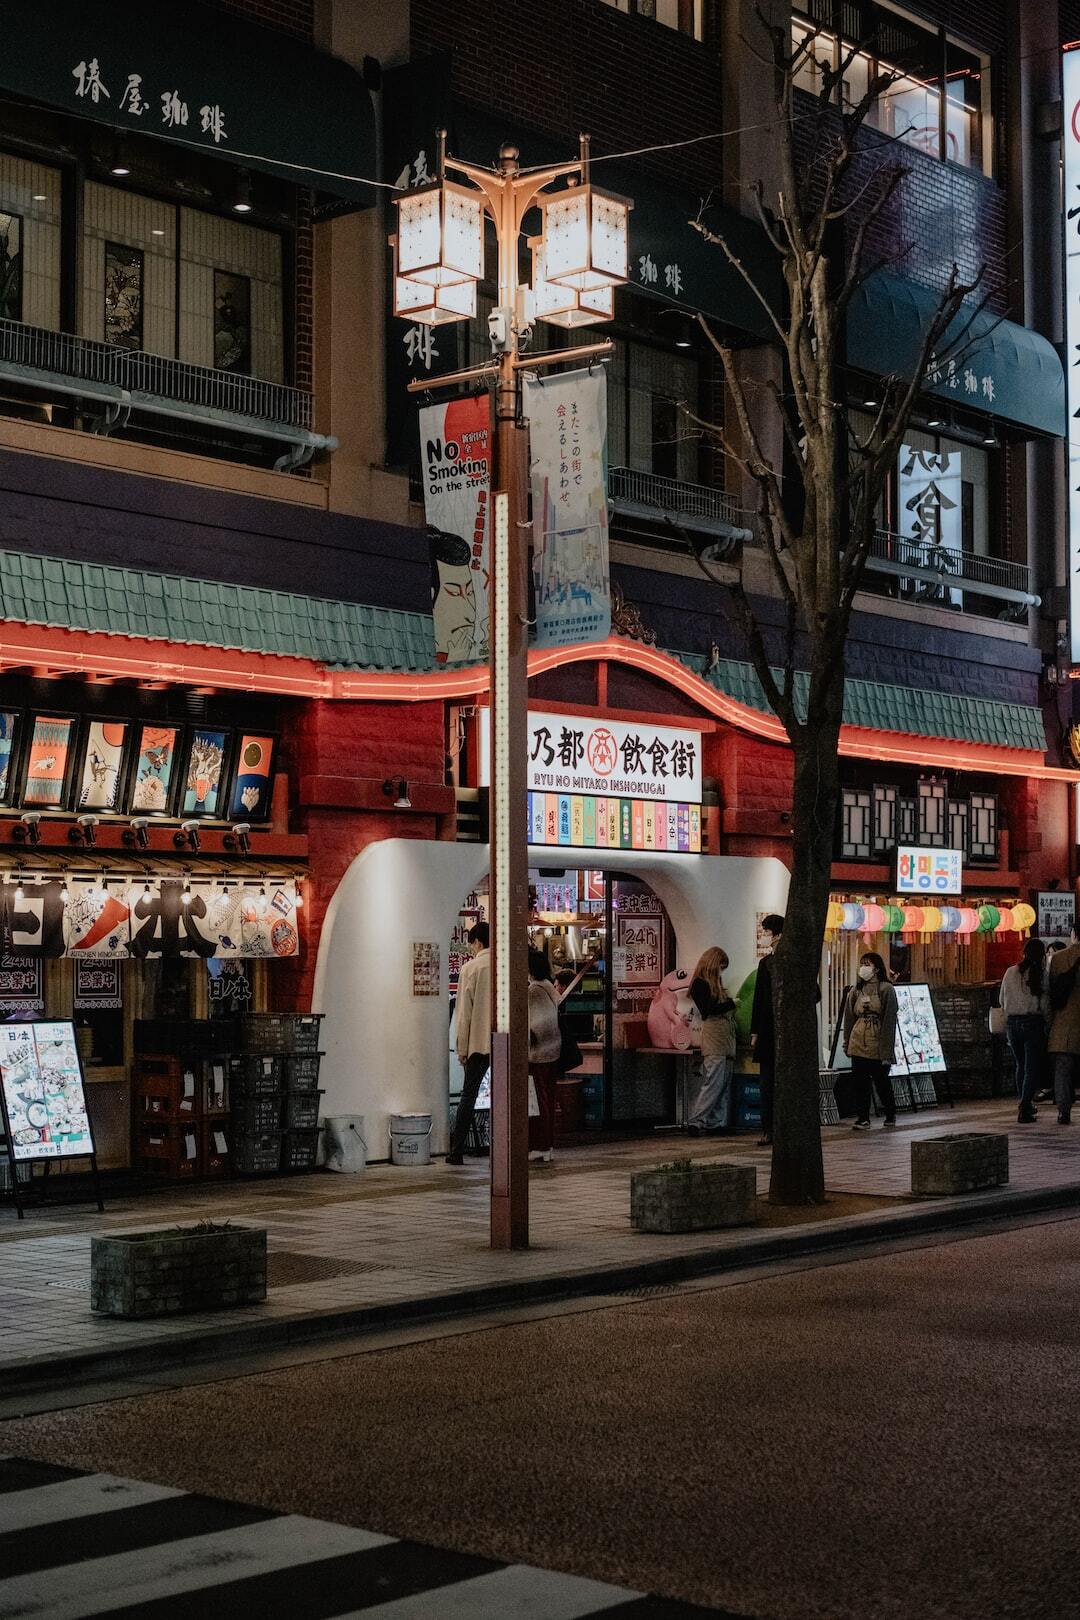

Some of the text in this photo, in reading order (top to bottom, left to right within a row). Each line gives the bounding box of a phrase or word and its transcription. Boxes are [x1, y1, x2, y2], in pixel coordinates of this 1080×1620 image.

[71, 57, 229, 143] 椿屋珈琲
[426, 438, 460, 465] No
[570, 400, 584, 486] またこの街で
[428, 457, 488, 482] Smoking
[429, 482, 443, 495] On
[446, 480, 463, 493] the
[619, 733, 697, 780] 飲食街
[533, 773, 666, 796] RYU NO MIYAKO INSHOKUGAI
[899, 854, 949, 889] 한명동
[625, 928, 657, 946] 24h
[79, 971, 116, 990] 営業中
